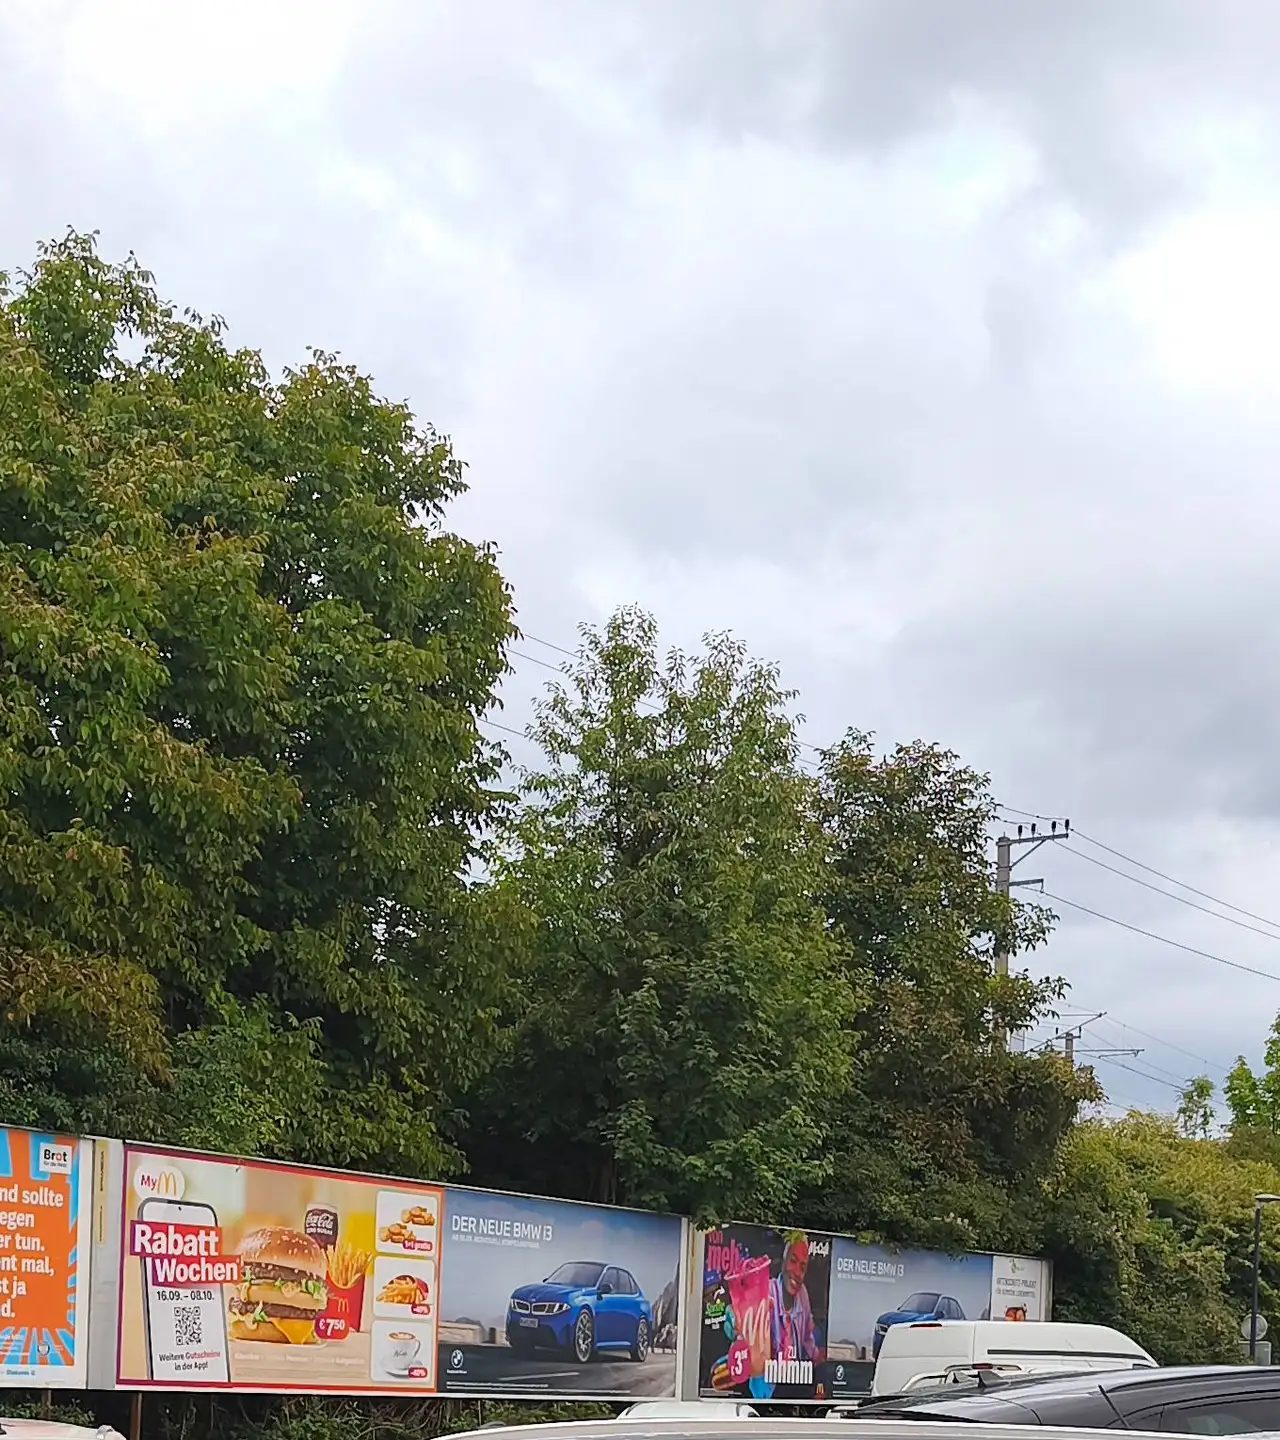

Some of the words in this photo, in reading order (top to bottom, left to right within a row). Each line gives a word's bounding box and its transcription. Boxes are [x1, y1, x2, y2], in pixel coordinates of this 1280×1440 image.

[43, 1149, 68, 1162] Brot
[141, 1175, 157, 1190] My
[22, 1187, 64, 1207] sollte
[452, 1215, 477, 1234] DER
[479, 1218, 511, 1237] NEUE
[513, 1222, 541, 1240] BMW
[15, 1233, 45, 1252] tun.
[134, 1224, 220, 1257] Rabatt
[21, 1256, 55, 1276] mal,
[837, 1258, 853, 1272] DER
[855, 1260, 877, 1274] NEUE
[878, 1262, 896, 1277] BMW
[11, 1276, 27, 1299] ja
[156, 1290, 183, 1301] 16.09.
[159, 1353, 184, 1361] Weitere
[765, 1352, 813, 1384] mhmm
